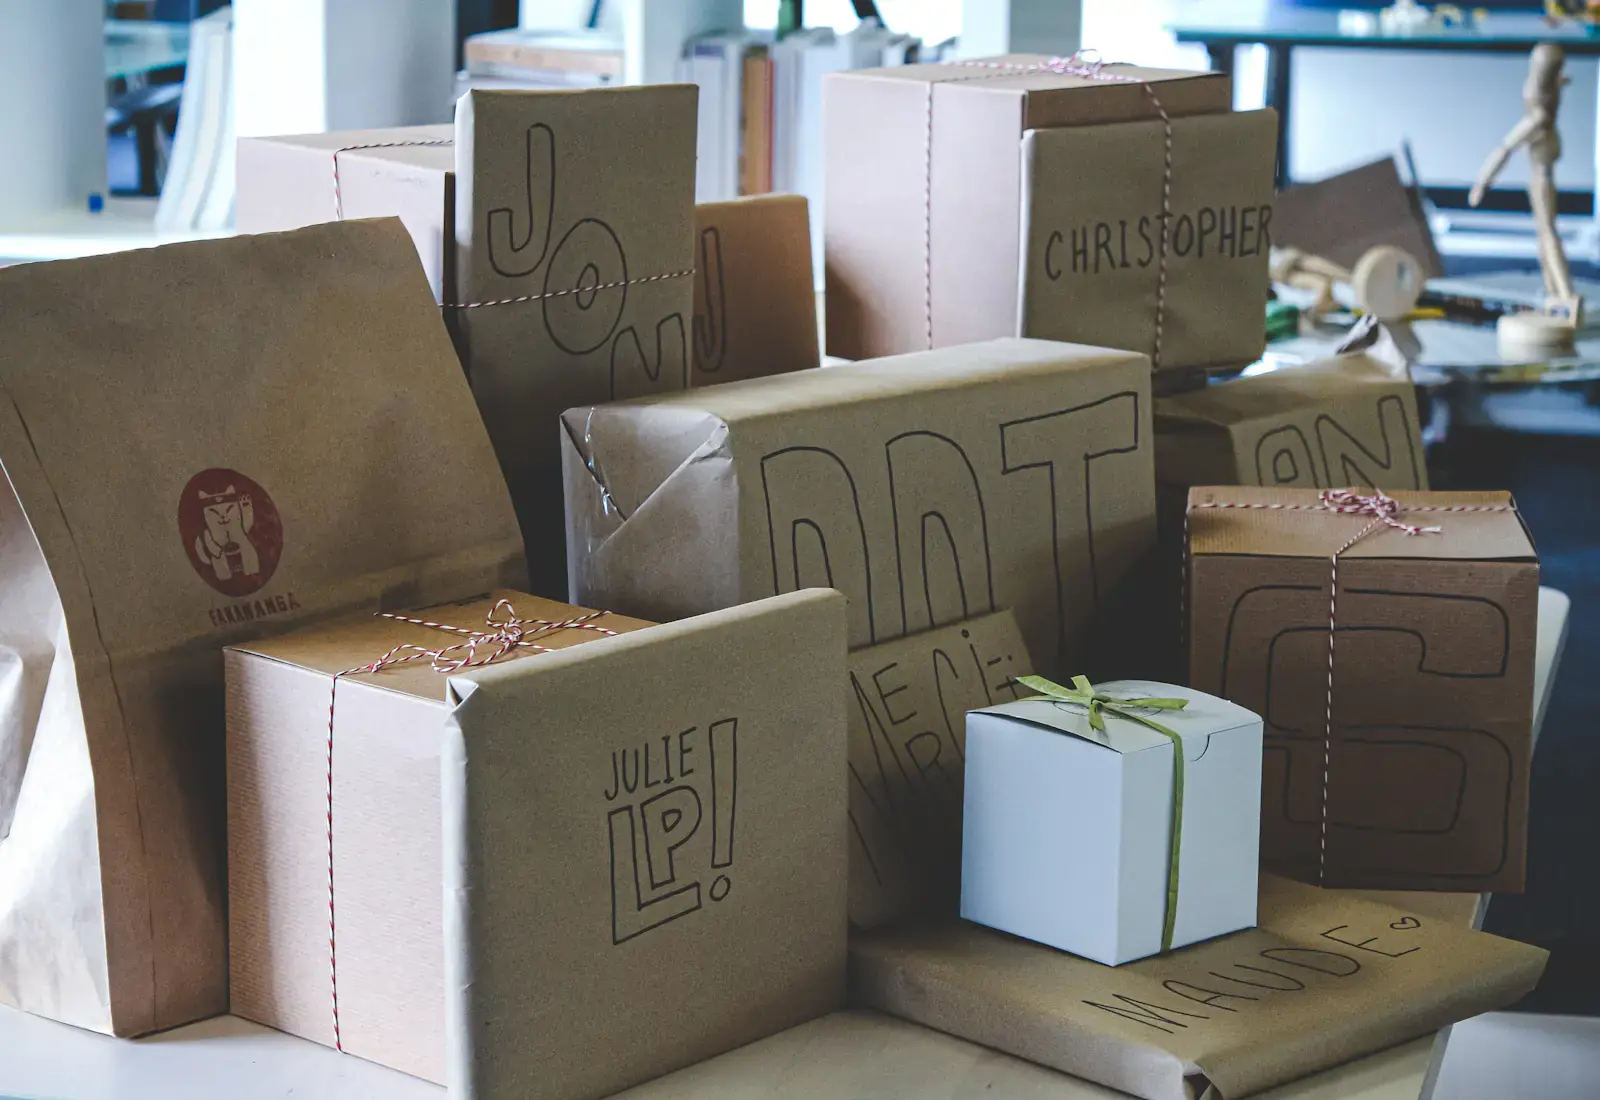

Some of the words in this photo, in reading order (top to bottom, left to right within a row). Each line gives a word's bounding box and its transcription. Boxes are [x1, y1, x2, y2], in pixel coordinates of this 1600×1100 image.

[1044, 204, 1273, 281] CHRISTOPHER
[604, 726, 697, 801] JULIE
[607, 717, 738, 946] LP!
[1081, 924, 1421, 1034] MAUDE
